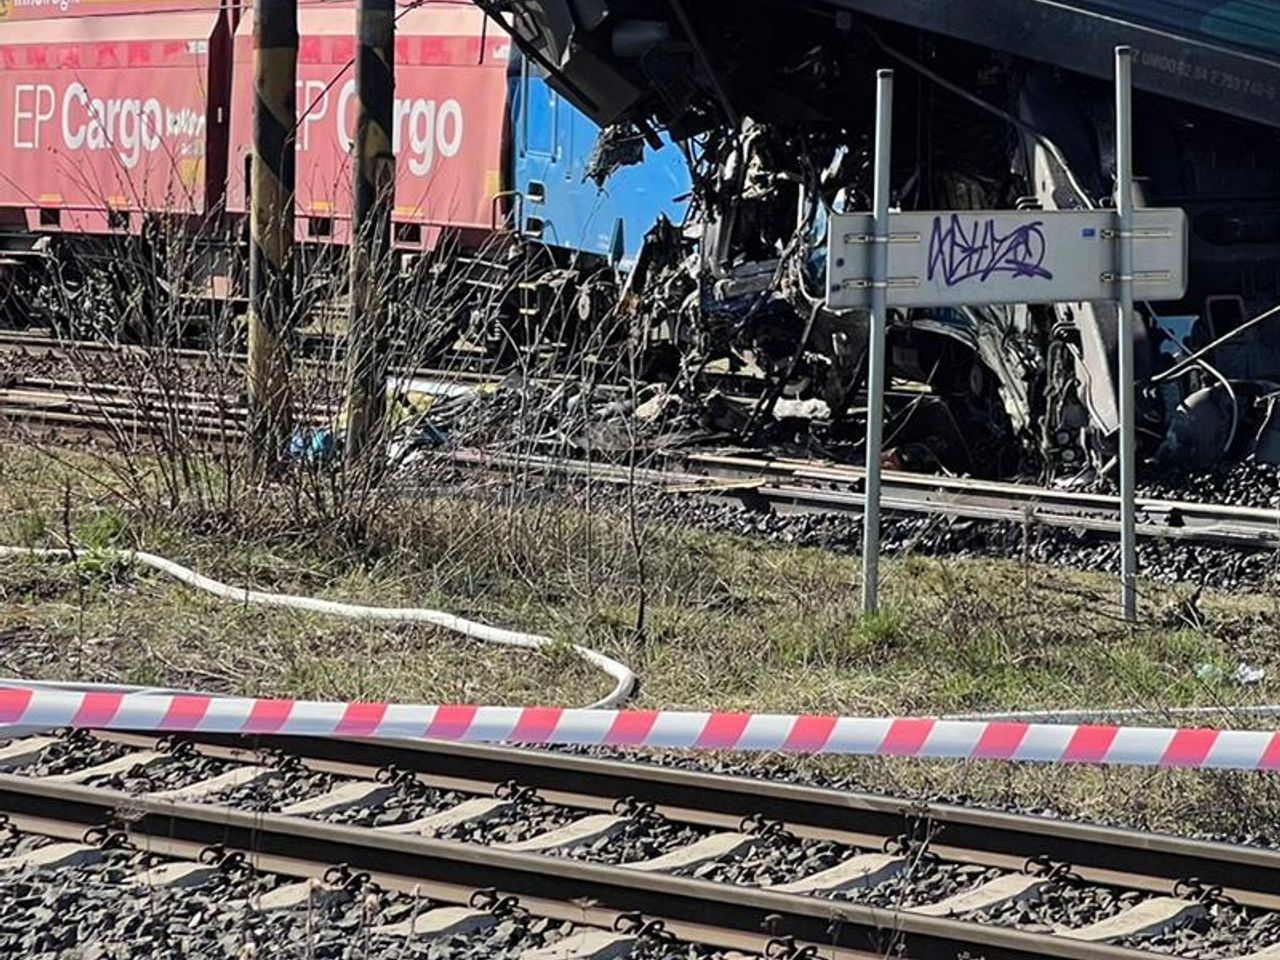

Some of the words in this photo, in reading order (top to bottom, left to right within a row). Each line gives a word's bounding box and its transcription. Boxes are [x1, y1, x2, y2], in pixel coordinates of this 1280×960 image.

[14, 84, 56, 148] EP
[62, 82, 162, 168] Cargo
[336, 79, 463, 176] Crgo
